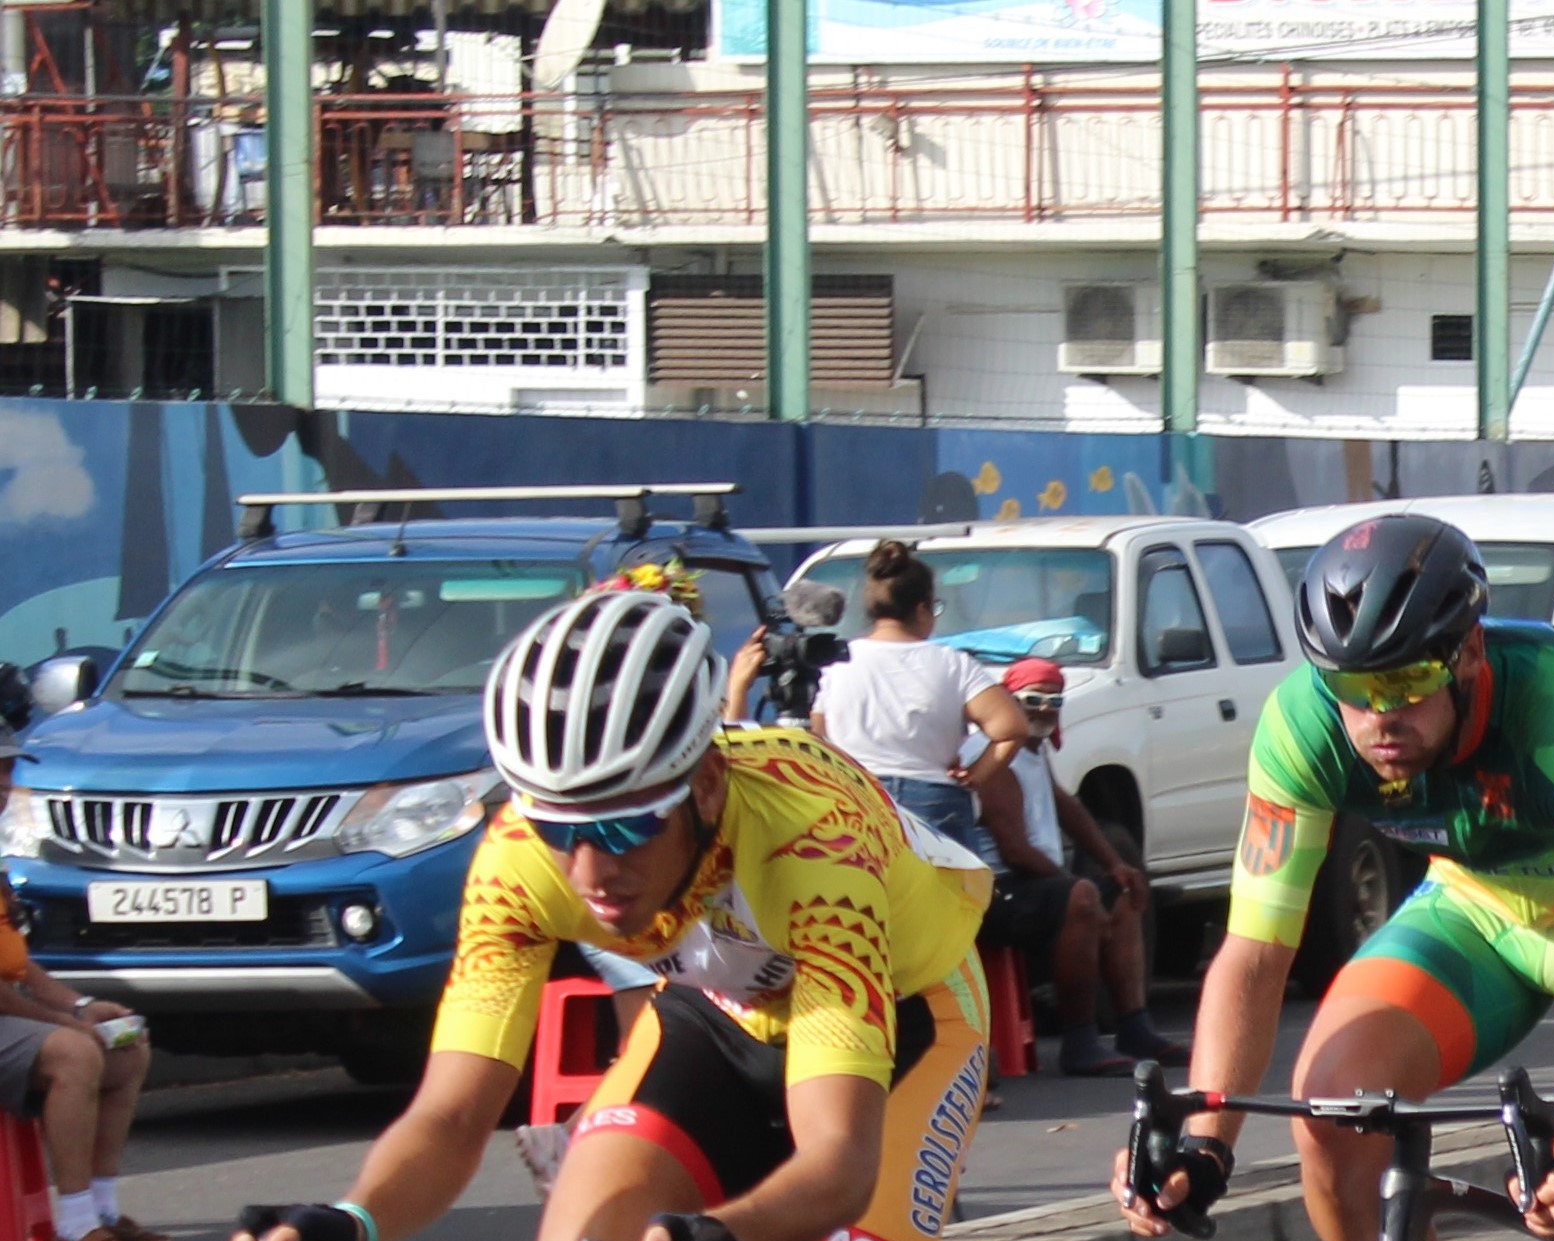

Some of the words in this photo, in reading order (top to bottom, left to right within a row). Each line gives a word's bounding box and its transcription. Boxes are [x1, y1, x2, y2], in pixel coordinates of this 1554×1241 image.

[1197, 22, 1272, 39] PECIALITES
[113, 887, 213, 916] 244578
[230, 886, 246, 914] P
